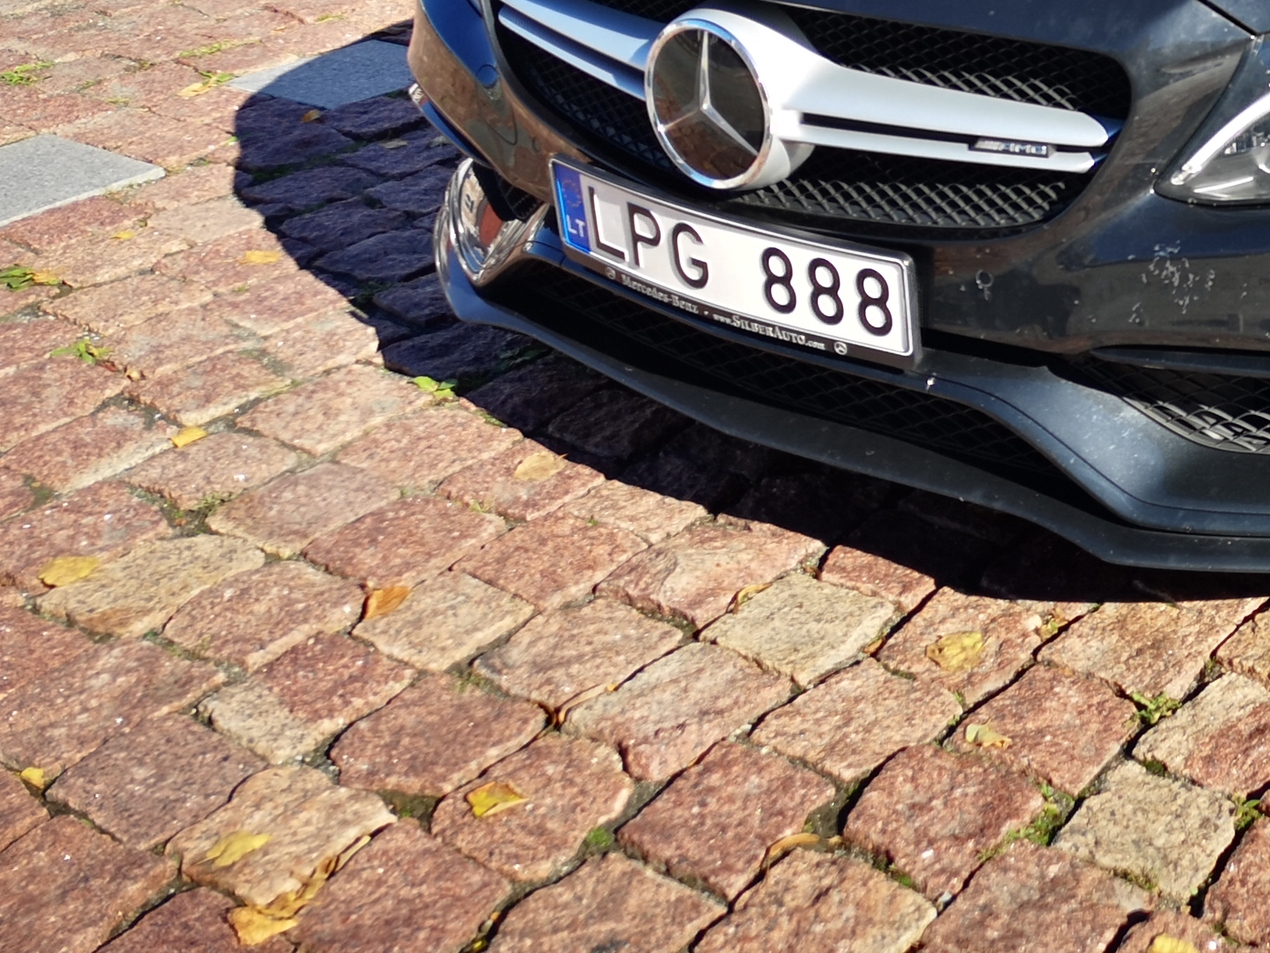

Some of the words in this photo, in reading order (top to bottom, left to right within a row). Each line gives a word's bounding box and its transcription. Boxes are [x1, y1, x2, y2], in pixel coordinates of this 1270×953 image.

[566, 214, 585, 237] LT
[588, 186, 709, 289] LPG
[761, 247, 893, 337] 888
[620, 273, 699, 314] Mercedes-Benz
